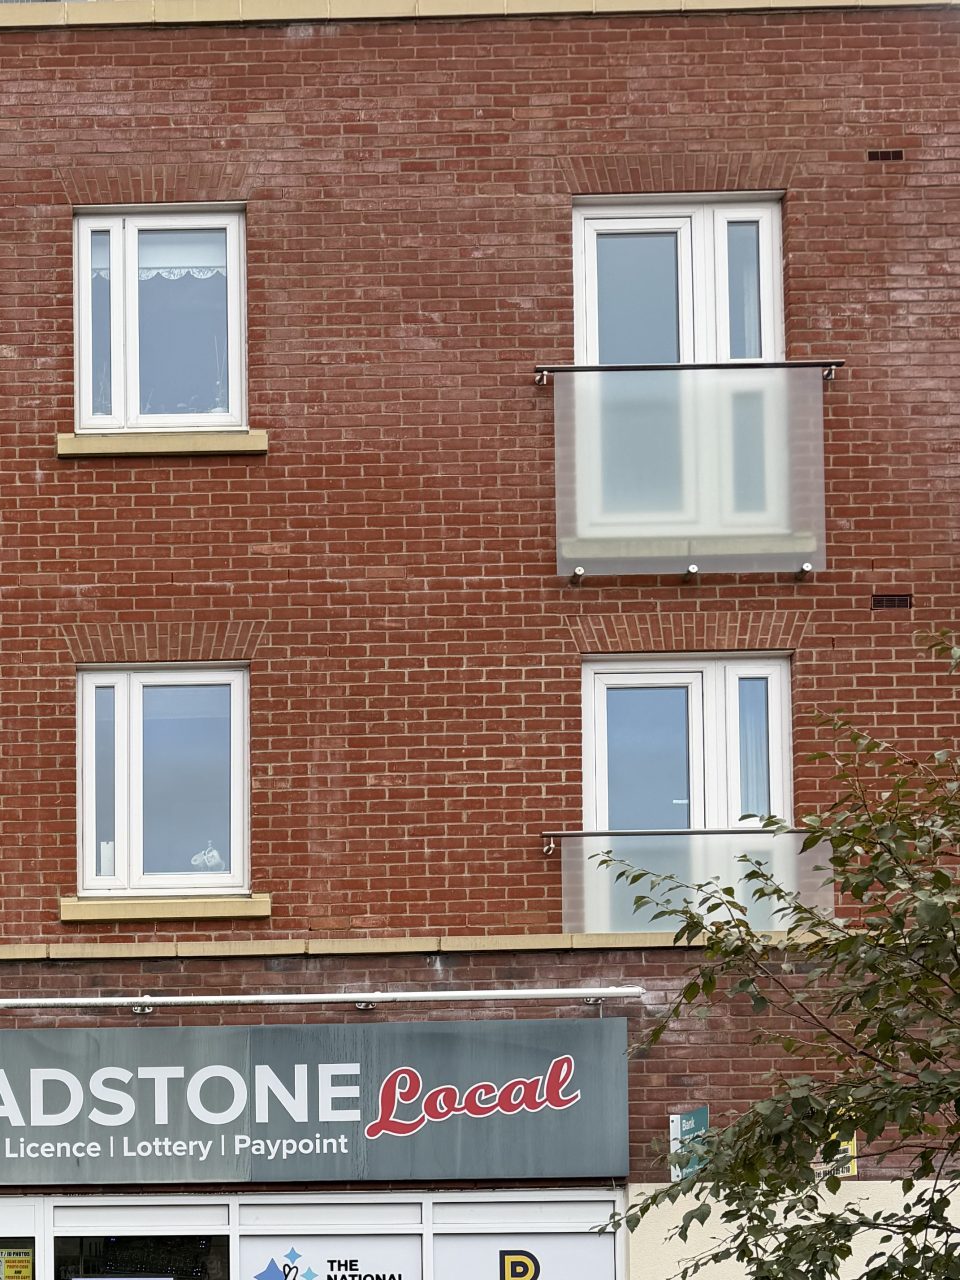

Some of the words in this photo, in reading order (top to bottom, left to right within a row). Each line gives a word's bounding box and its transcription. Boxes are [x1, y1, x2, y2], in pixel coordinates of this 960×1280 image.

[364, 1054, 582, 1140] Local
[682, 1116, 695, 1131] Bank
[5, 1135, 101, 1160] Licence
[122, 1134, 213, 1163] Lottery
[234, 1132, 348, 1162] Paypoint
[326, 1259, 359, 1272] THE
